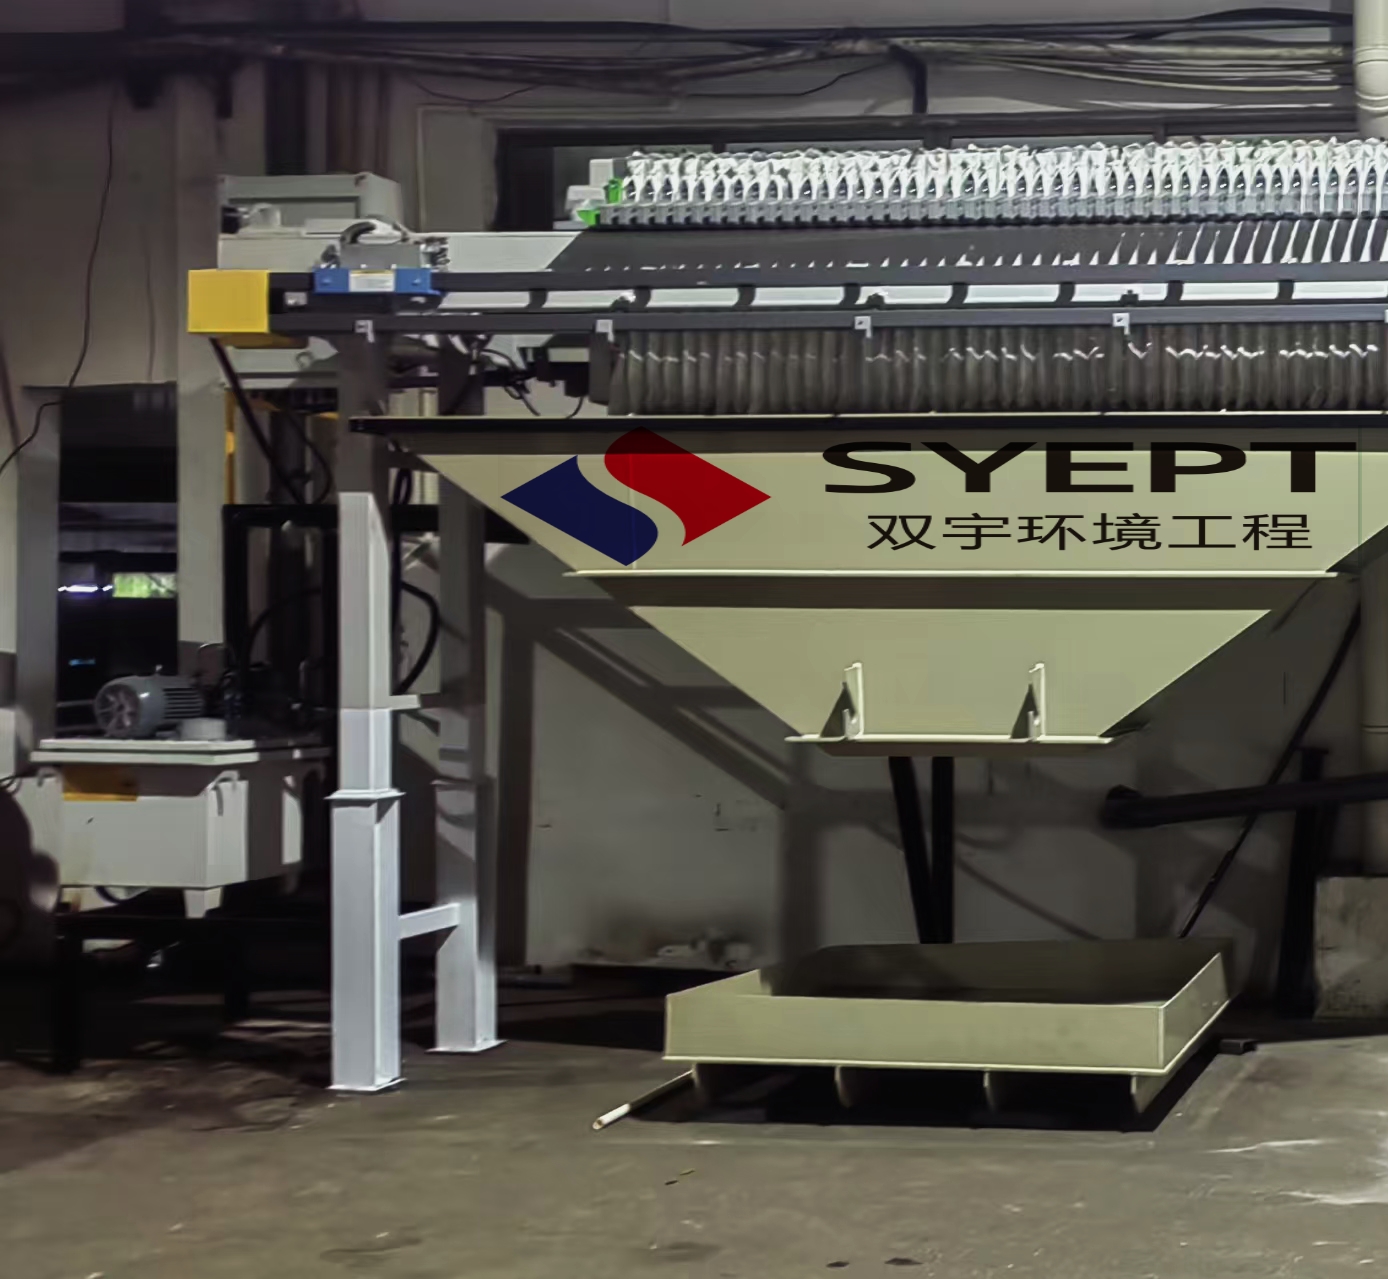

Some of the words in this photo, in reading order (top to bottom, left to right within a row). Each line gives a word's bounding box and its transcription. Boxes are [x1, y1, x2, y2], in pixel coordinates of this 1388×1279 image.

[822, 441, 1358, 494] SYEPT
[867, 513, 1313, 551] 双宇环境工程
